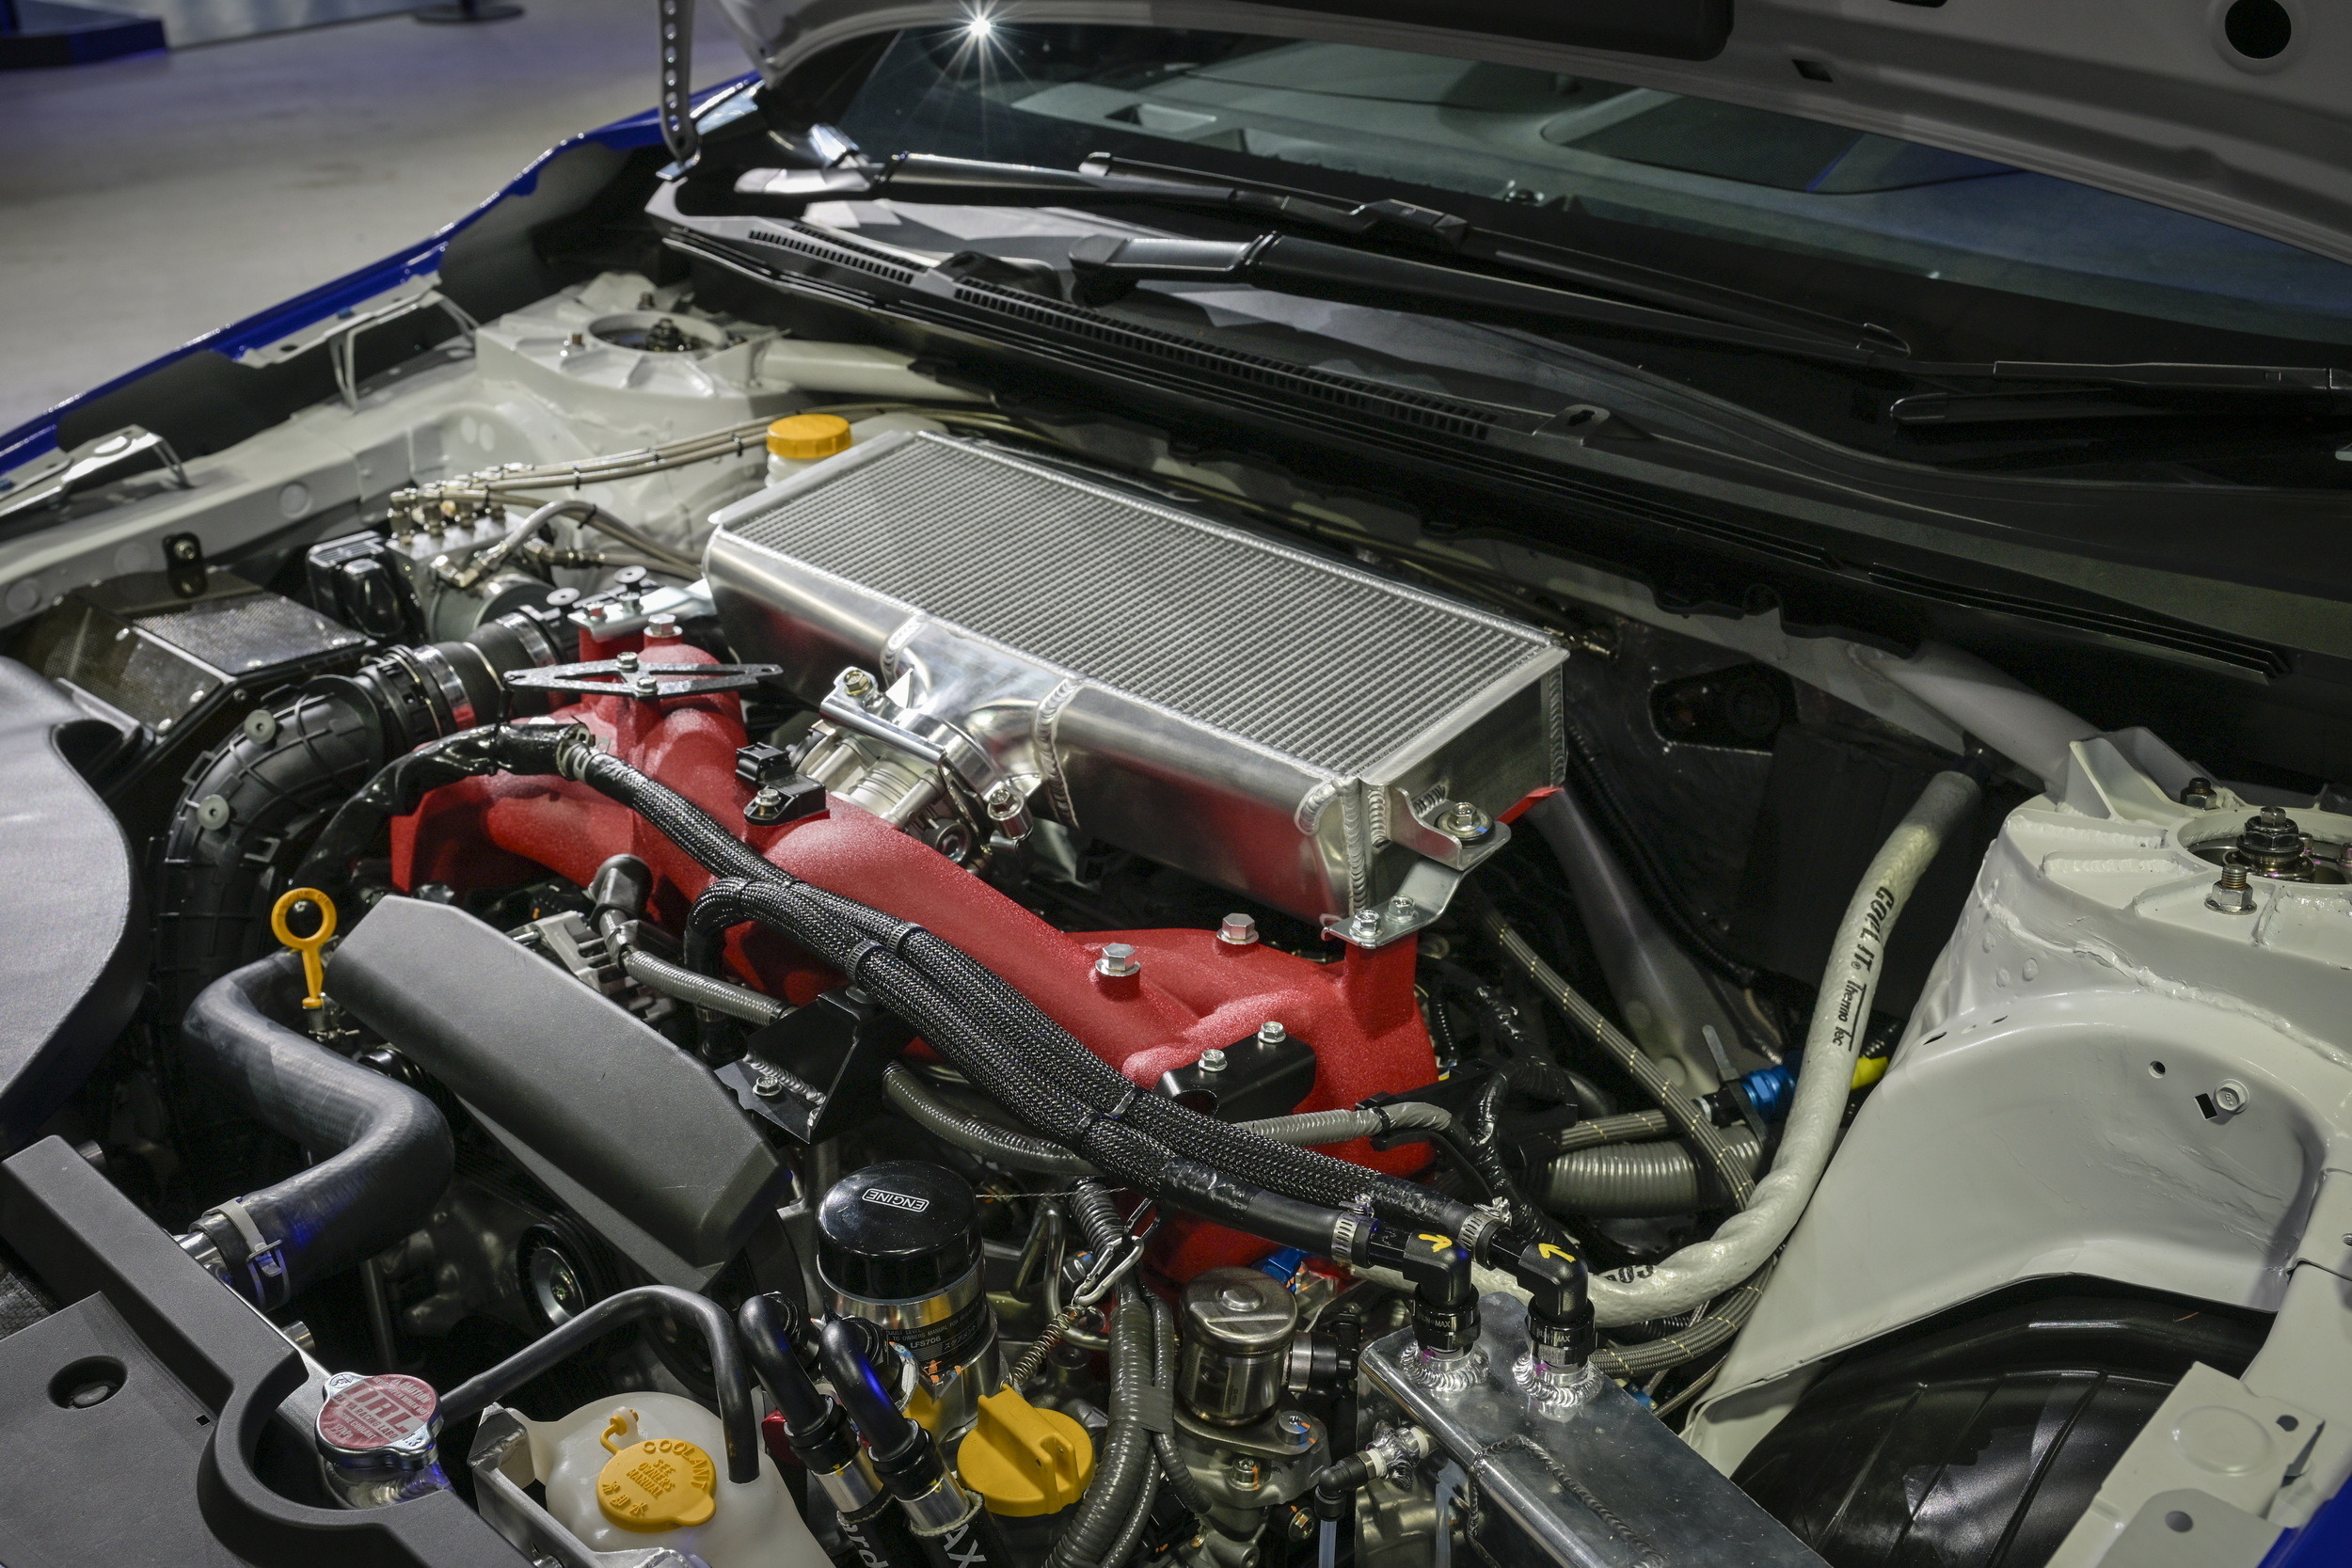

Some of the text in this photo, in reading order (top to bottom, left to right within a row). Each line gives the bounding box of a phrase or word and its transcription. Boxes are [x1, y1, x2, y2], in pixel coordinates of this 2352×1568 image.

[868, 1190, 925, 1211] ENGINE
[910, 1336, 942, 1350] LFS706
[399, 1380, 431, 1403] CAUTION
[343, 1383, 411, 1433] DRL
[350, 1419, 376, 1440] COOLANT
[354, 1407, 381, 1427] RACING
[378, 1424, 398, 1439] LABO
[637, 1462, 675, 1493] OWNERS
[643, 1440, 709, 1489] COOLANT
[653, 1459, 675, 1477] SEE
[626, 1468, 663, 1499] MANUAL
